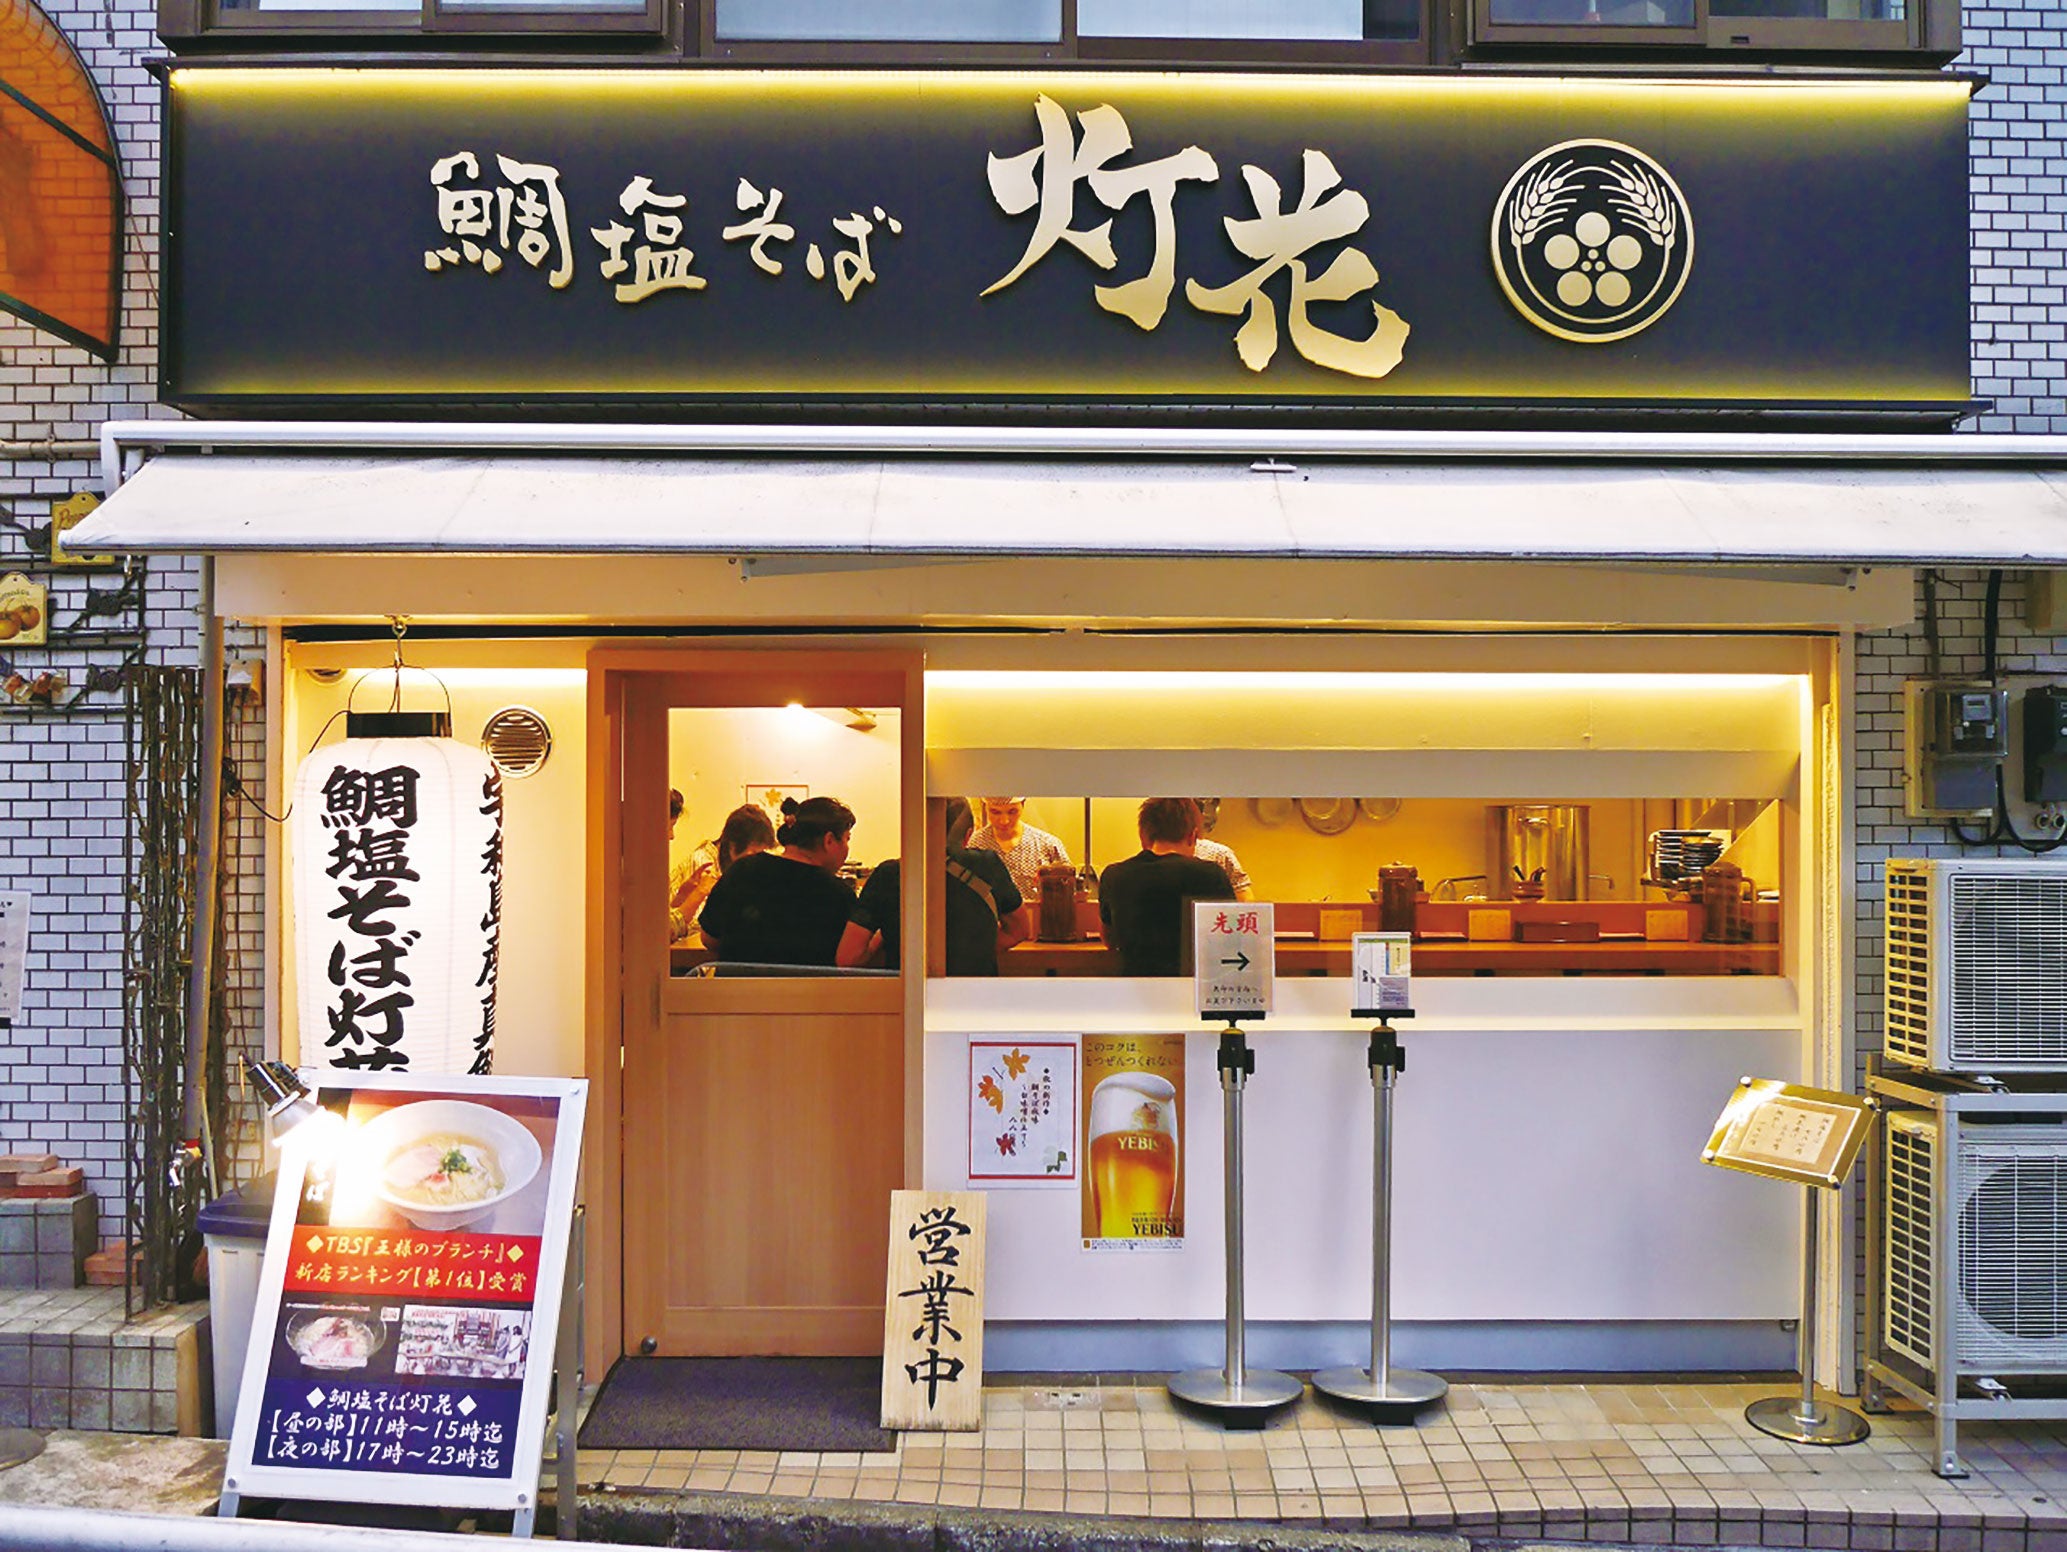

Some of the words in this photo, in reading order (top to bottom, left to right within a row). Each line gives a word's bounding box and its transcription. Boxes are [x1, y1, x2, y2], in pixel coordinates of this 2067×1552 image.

[424, 152, 901, 302] 鯛塩そば
[979, 92, 1411, 379] 灯花
[1211, 911, 1258, 934] 先頭
[897, 1206, 975, 1412] 営業中
